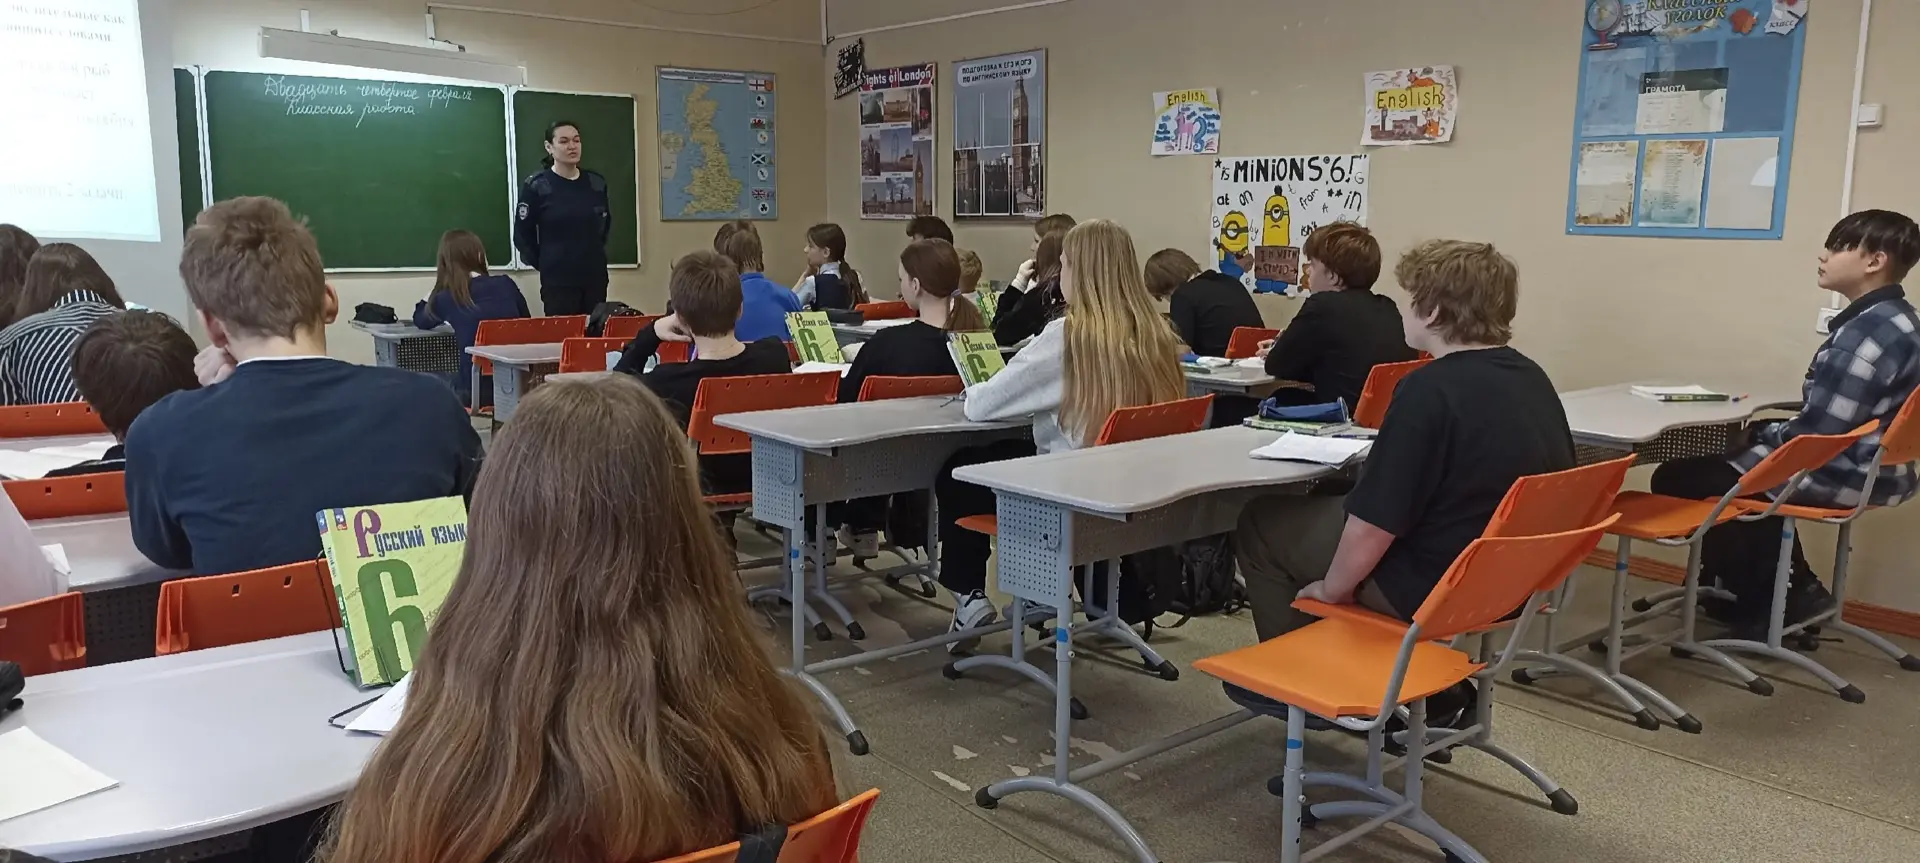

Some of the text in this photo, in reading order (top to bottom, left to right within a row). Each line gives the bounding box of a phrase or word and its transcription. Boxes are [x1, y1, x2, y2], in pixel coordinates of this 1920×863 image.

[103, 13, 126, 25] как
[863, 68, 931, 87] ights of London
[962, 64, 998, 74] ПОДГОТОВКА
[962, 76, 971, 84] ПО
[1011, 67, 1031, 77] ЯЗЫКУ
[264, 75, 347, 105] Двадцать
[1167, 90, 1206, 106] English
[1376, 86, 1444, 109] English
[1645, 84, 1686, 94] ГРАМОТА
[285, 96, 355, 116] Классная
[1221, 166, 1230, 181] is
[1216, 189, 1254, 206] at on
[1299, 188, 1319, 210] from
[1343, 190, 1362, 212] in
[353, 508, 468, 559] Русский язык
[357, 558, 428, 683] 6
